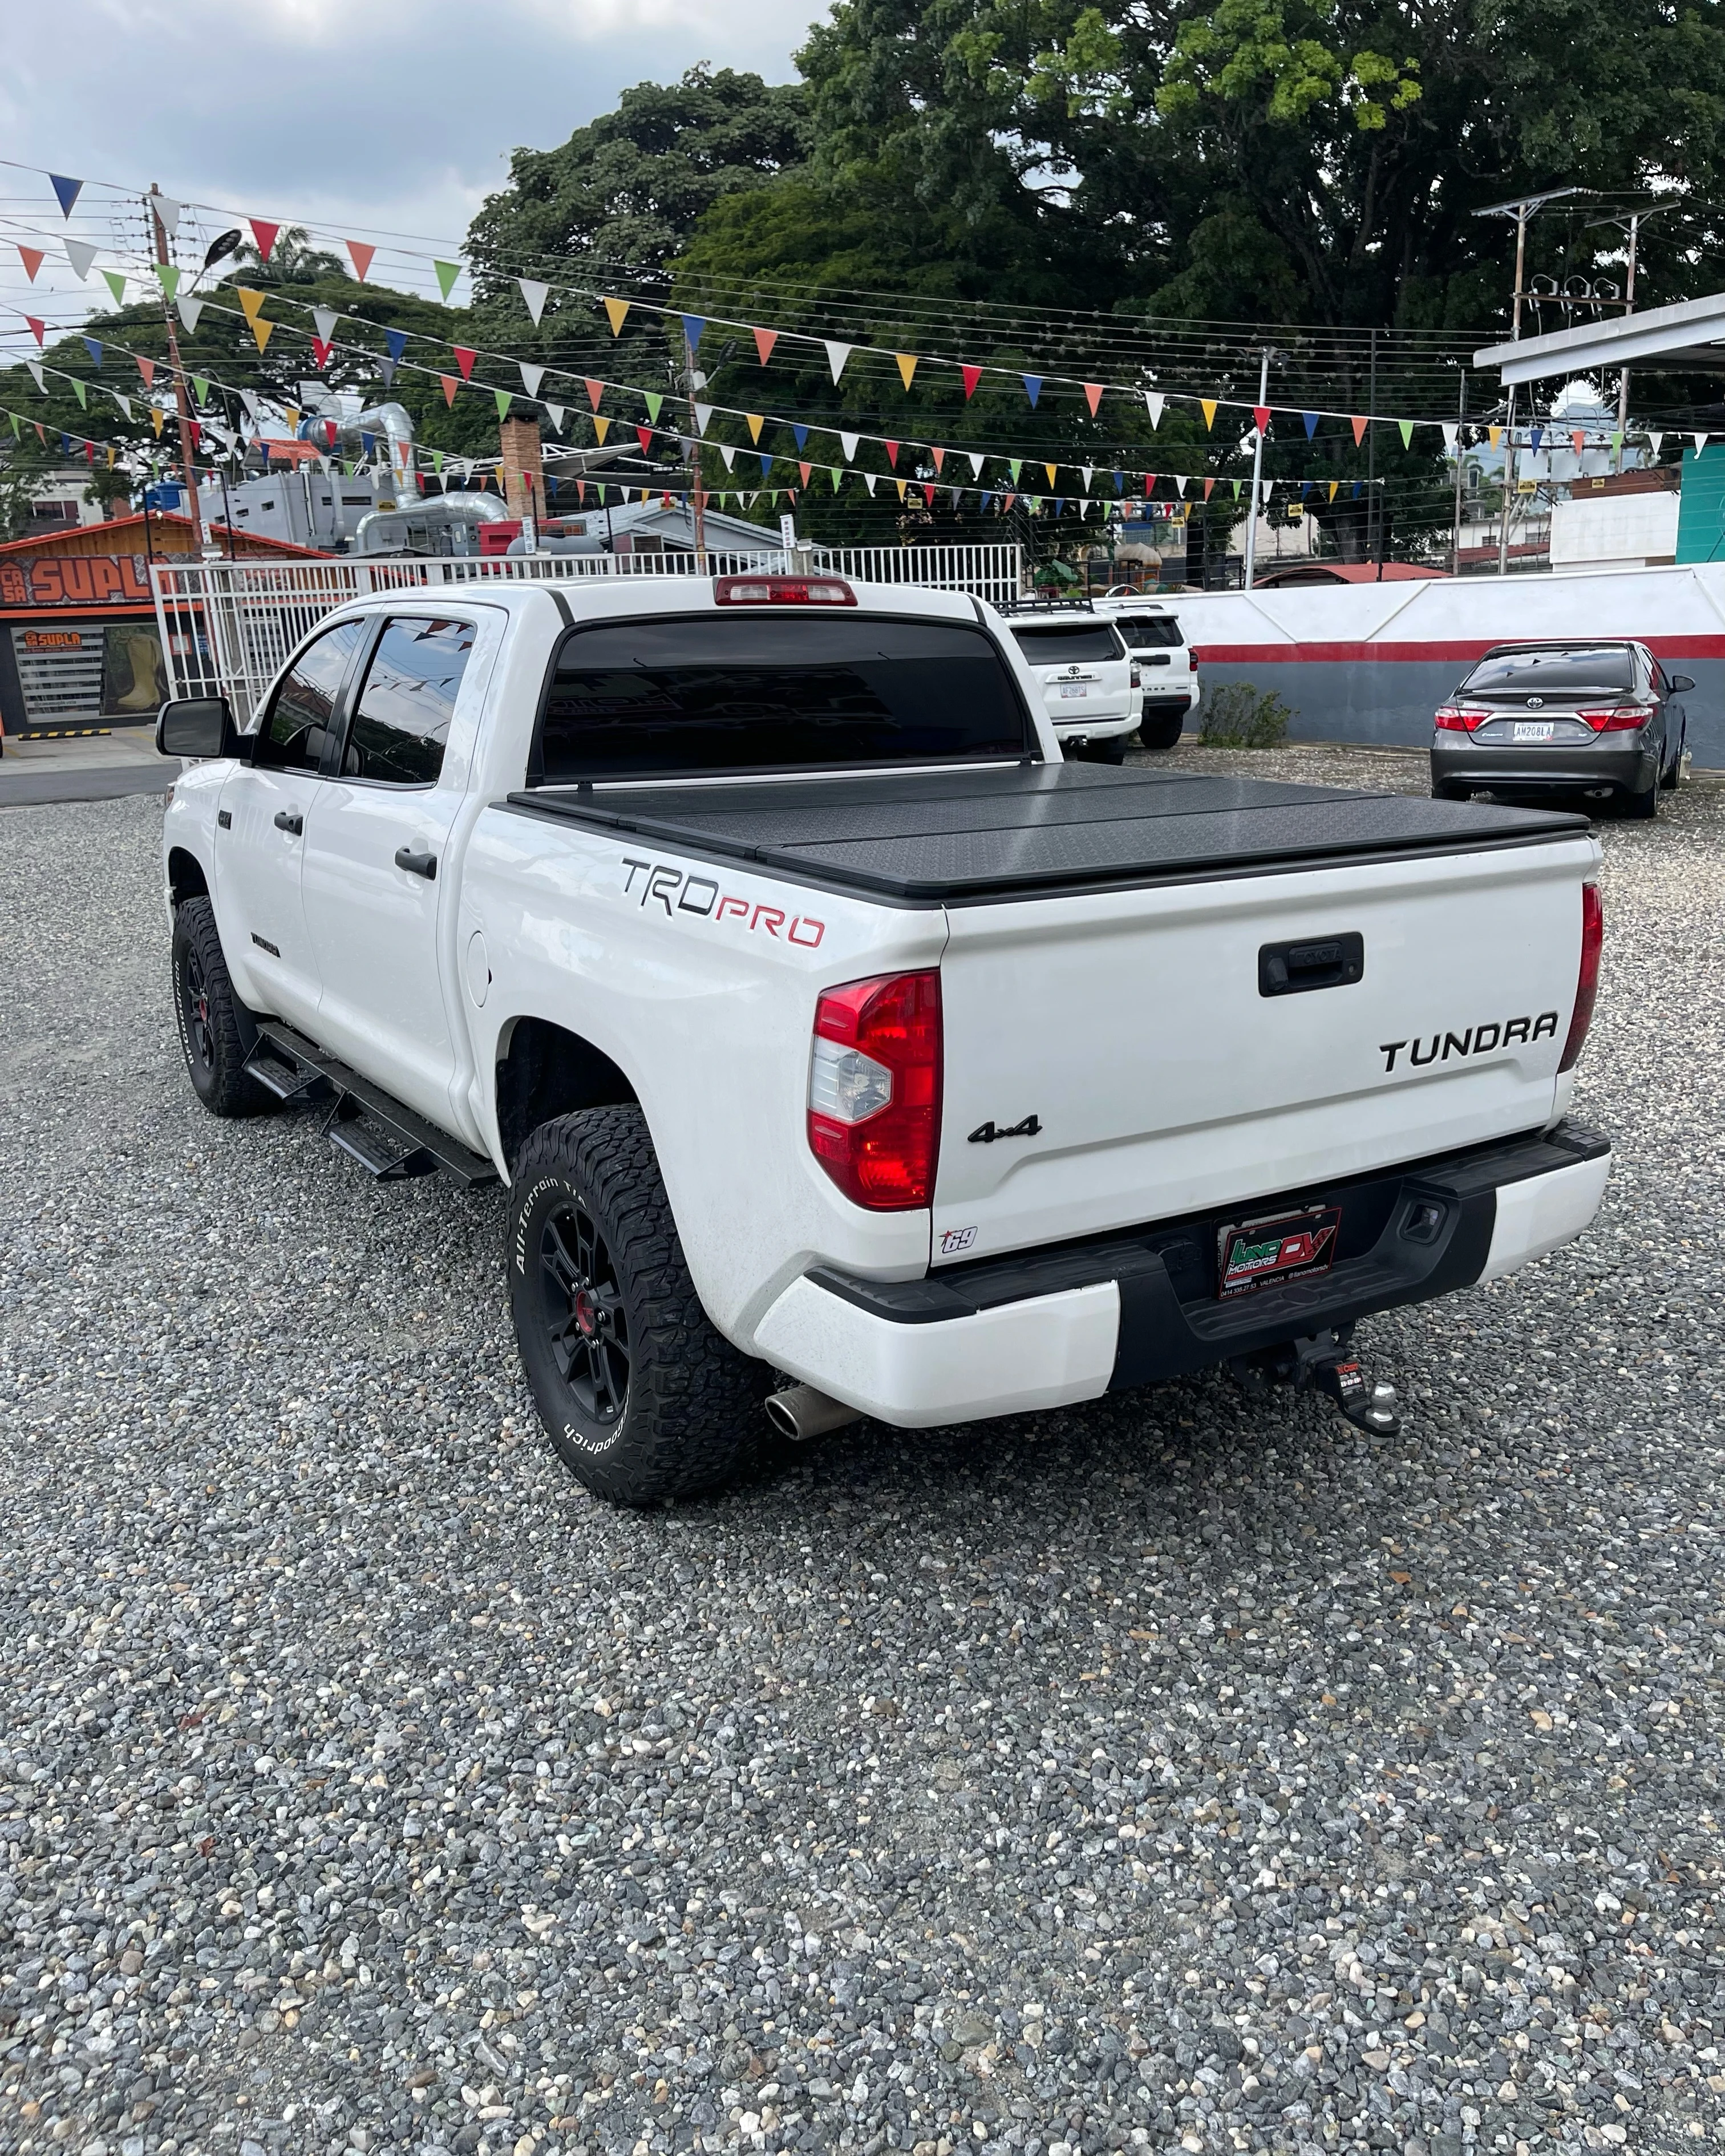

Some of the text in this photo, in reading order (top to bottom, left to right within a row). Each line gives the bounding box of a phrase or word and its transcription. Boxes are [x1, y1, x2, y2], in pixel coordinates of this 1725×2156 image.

[32, 557, 177, 601] SUPLA
[38, 633, 81, 646] SUPLA
[1516, 727, 1551, 736] AM208LA
[622, 858, 825, 949] TRD PRO
[1296, 947, 1342, 964] TOYOTA
[175, 960, 195, 1064] BFGoodrich
[1379, 1010, 1560, 1072] TUNDRA
[516, 1176, 559, 1275] All-Terrain
[942, 1226, 978, 1254] 69
[1232, 1239, 1283, 1265] LLANO
[1228, 1255, 1278, 1275] MOTORS
[1260, 1275, 1285, 1287] VALENCIA
[564, 1383, 630, 1455] Goodrich
